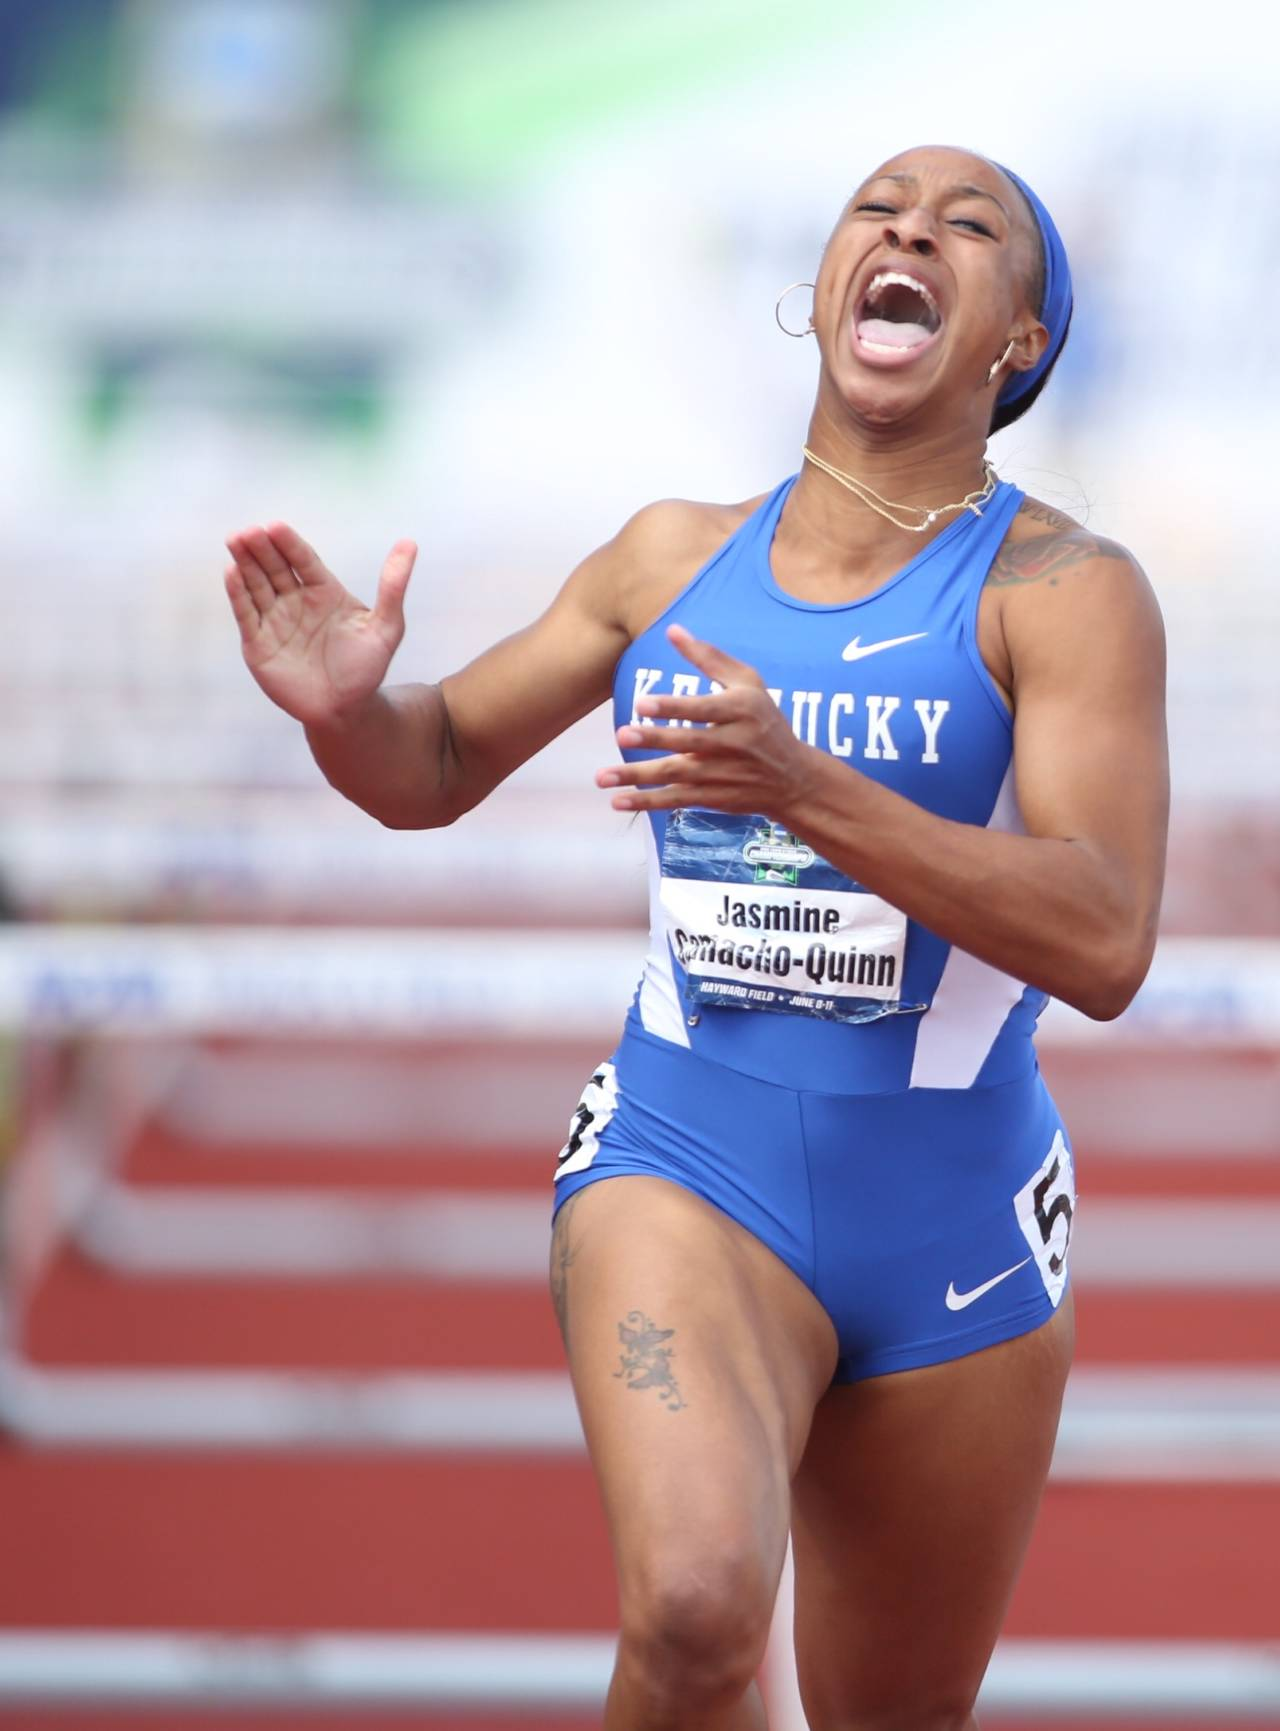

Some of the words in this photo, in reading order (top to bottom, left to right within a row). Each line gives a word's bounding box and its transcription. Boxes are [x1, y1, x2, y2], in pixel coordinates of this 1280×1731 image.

[629, 667, 950, 764] KEUCKY
[716, 894, 840, 934] Jasmine
[701, 981, 748, 998] HAYWARD
[748, 989, 774, 1001] FIELD
[789, 995, 815, 1008] JUNE
[1033, 1156, 1073, 1277] 5
